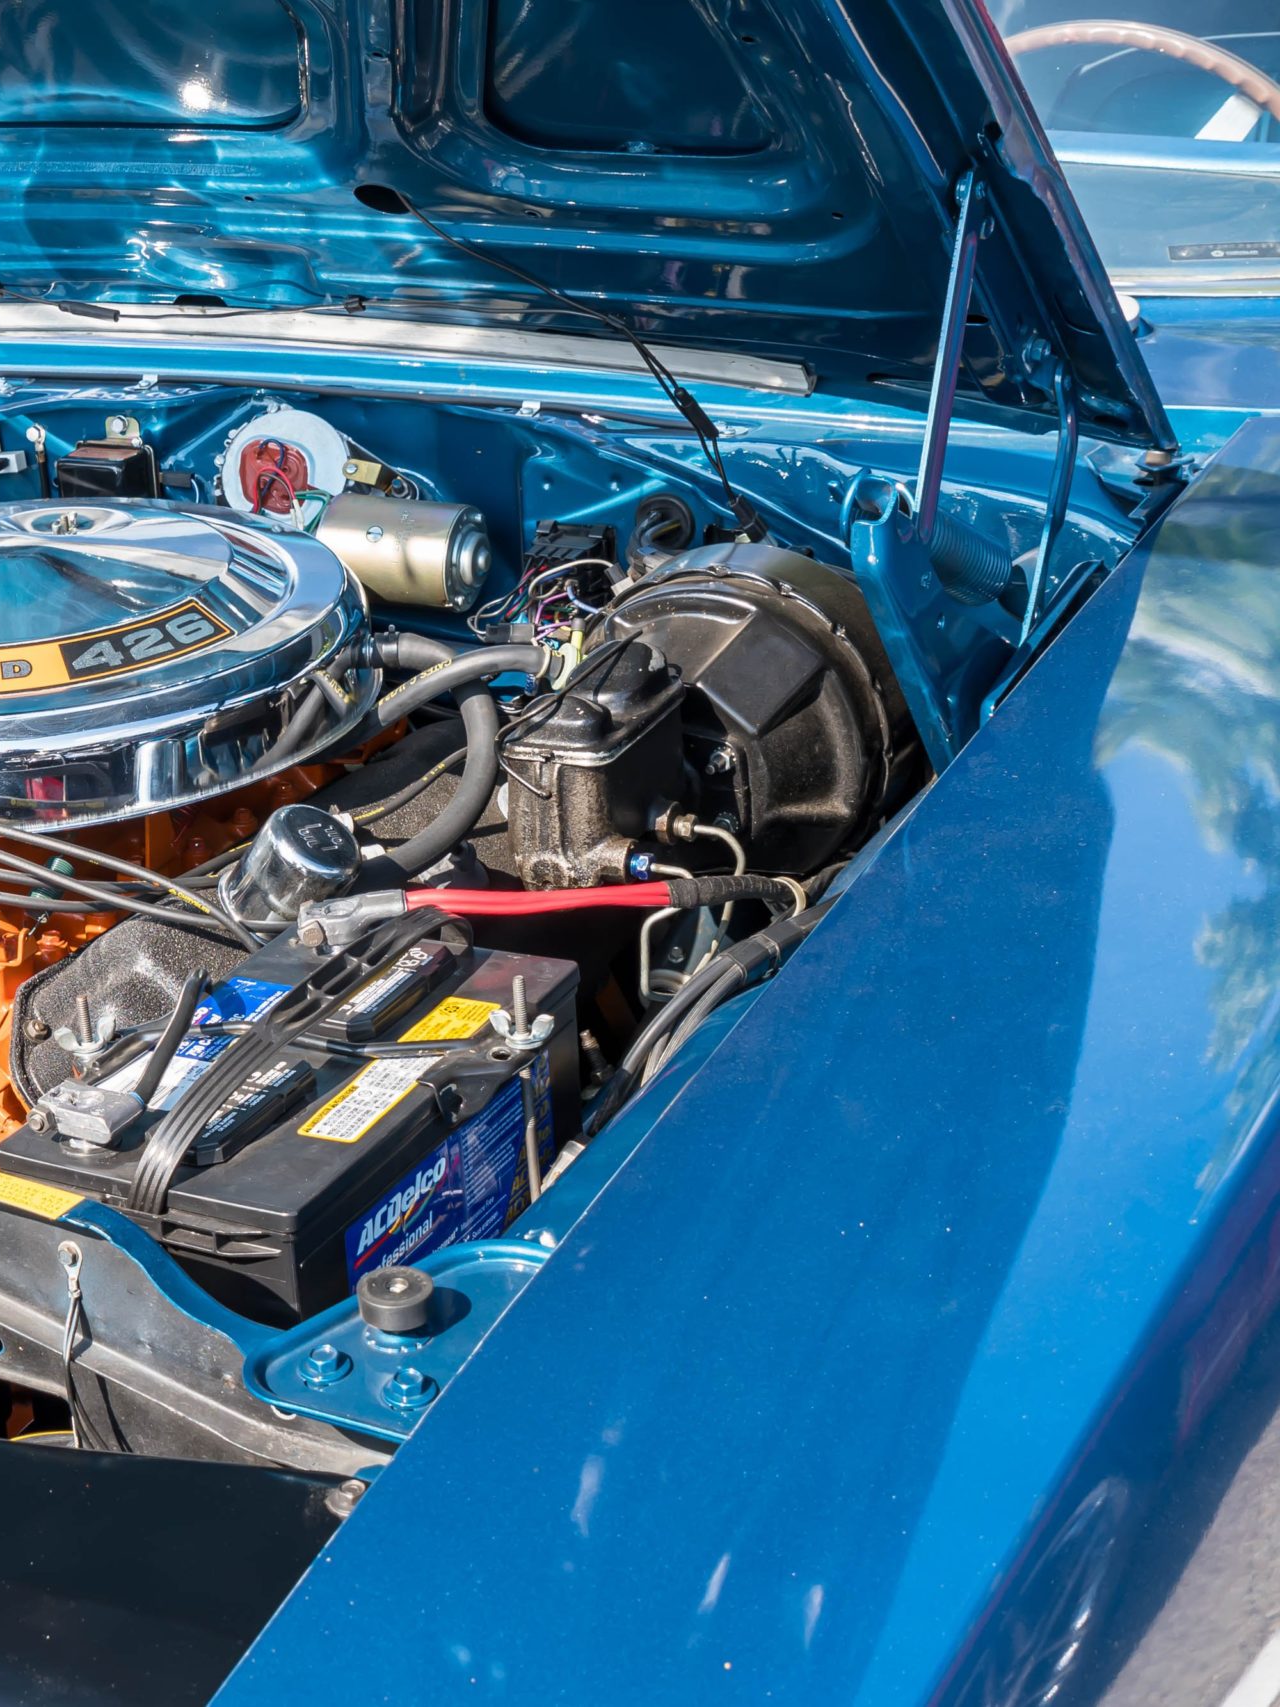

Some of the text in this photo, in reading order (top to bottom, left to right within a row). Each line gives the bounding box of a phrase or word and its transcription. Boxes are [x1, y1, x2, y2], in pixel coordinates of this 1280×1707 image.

[71, 612, 215, 671] 426
[356, 1157, 446, 1256] ACDelco
[370, 1211, 433, 1271] fessional
